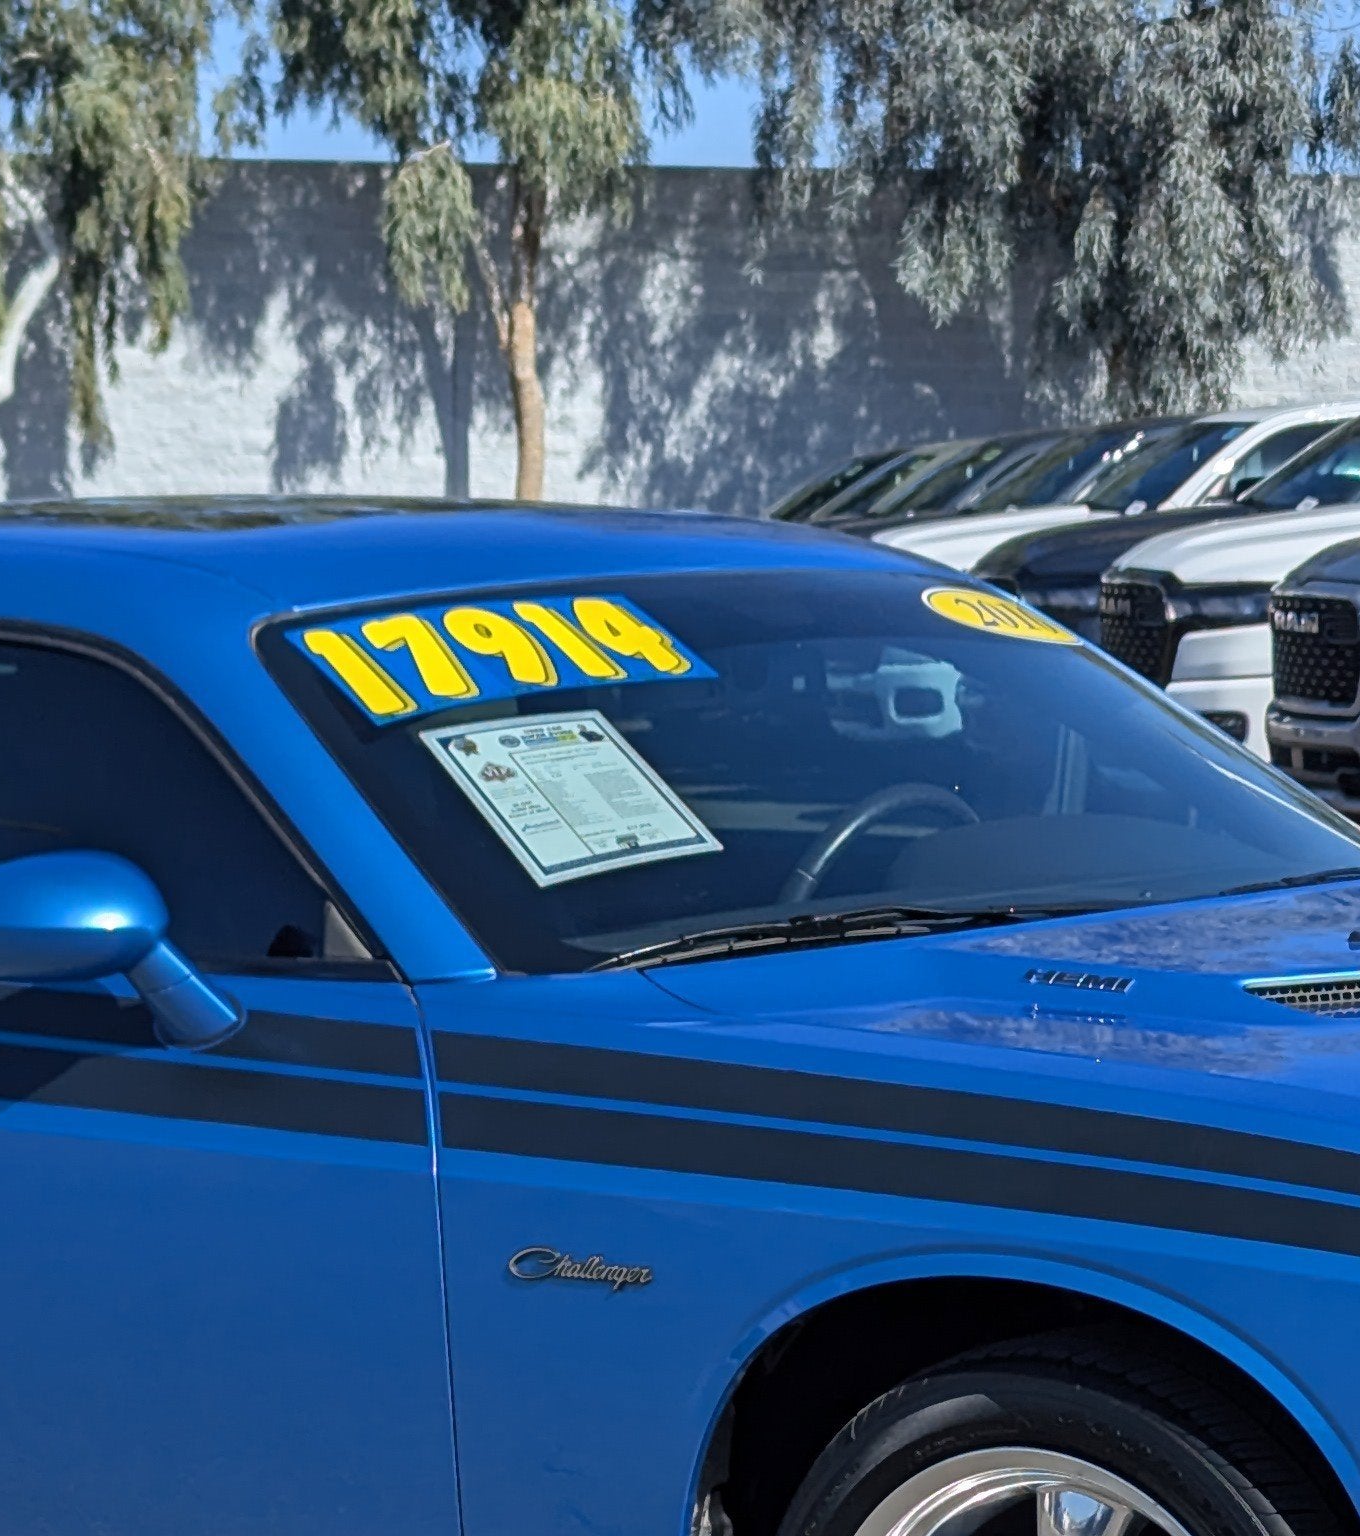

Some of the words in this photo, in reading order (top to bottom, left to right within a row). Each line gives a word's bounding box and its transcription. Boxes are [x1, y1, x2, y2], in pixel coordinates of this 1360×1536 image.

[1274, 610, 1319, 633] RAM
[304, 597, 691, 715] 17914
[508, 1247, 653, 1290] Challenger
